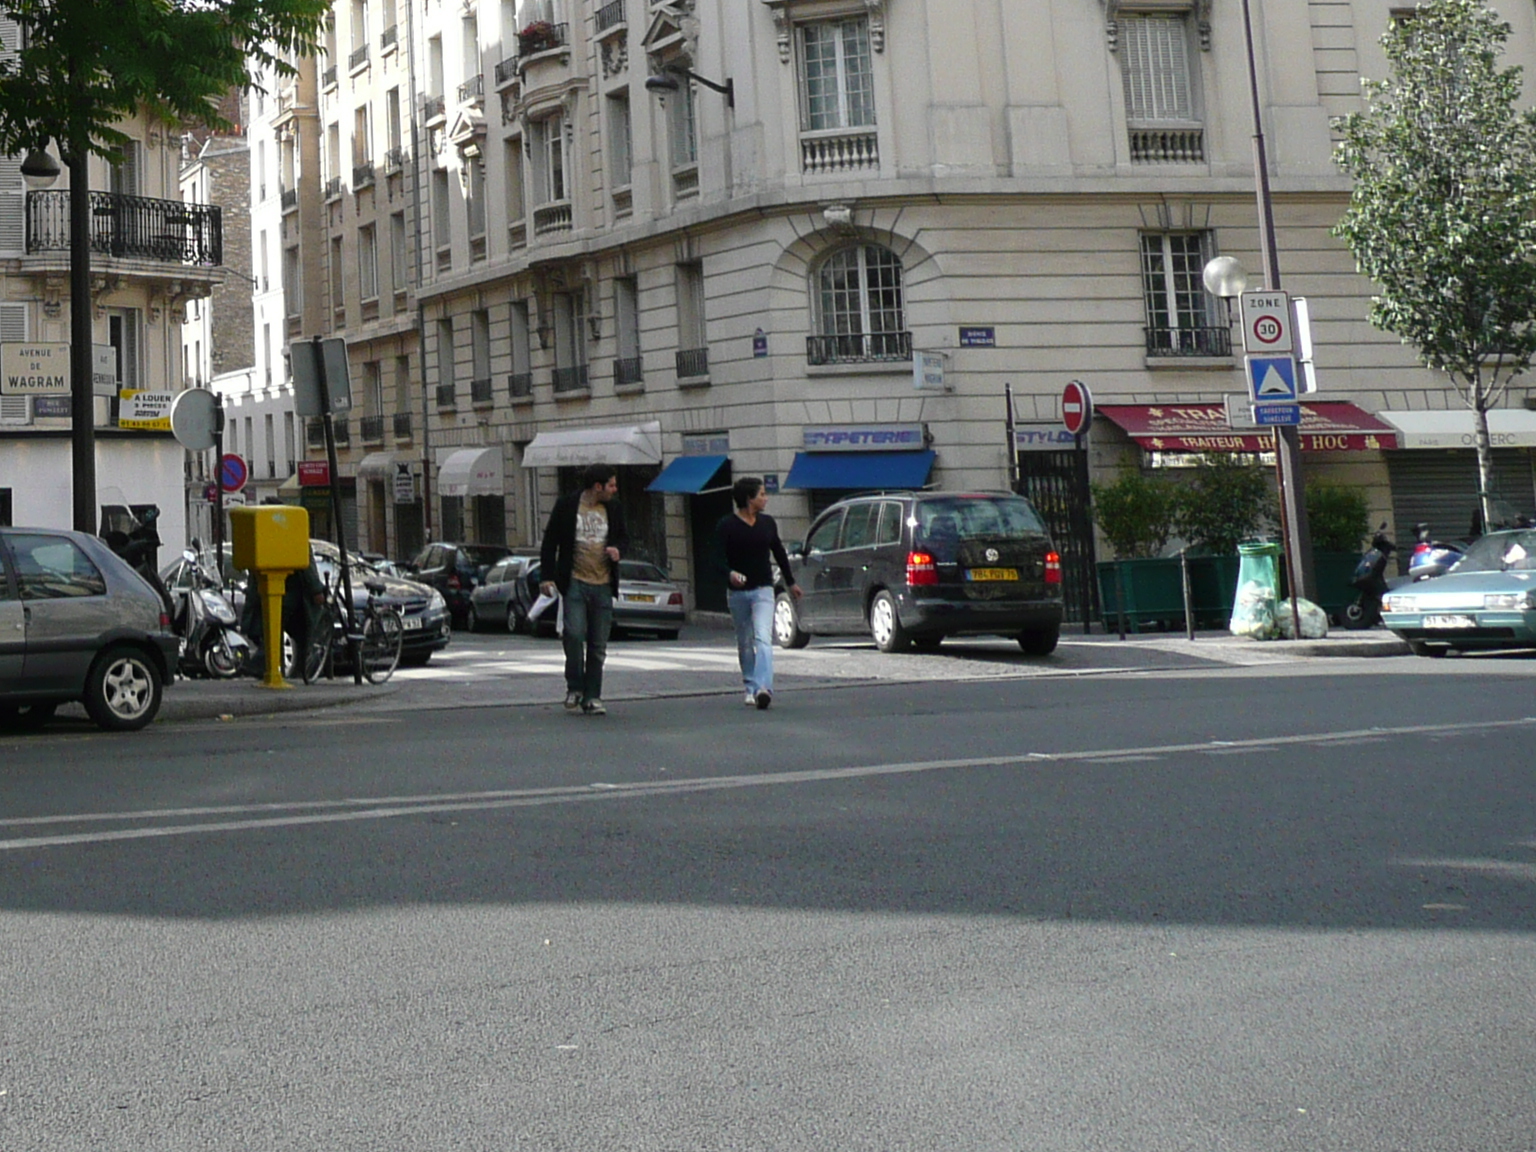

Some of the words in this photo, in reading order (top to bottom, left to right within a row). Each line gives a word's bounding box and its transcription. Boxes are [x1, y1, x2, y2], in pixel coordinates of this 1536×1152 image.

[1250, 299, 1280, 308] ZONE
[1260, 324, 1276, 335] 30
[8, 376, 64, 388] WAGRAM
[813, 431, 911, 444] PAPETERIE
[1179, 437, 1245, 449] TRAITEUR
[1312, 436, 1348, 449] HOC
